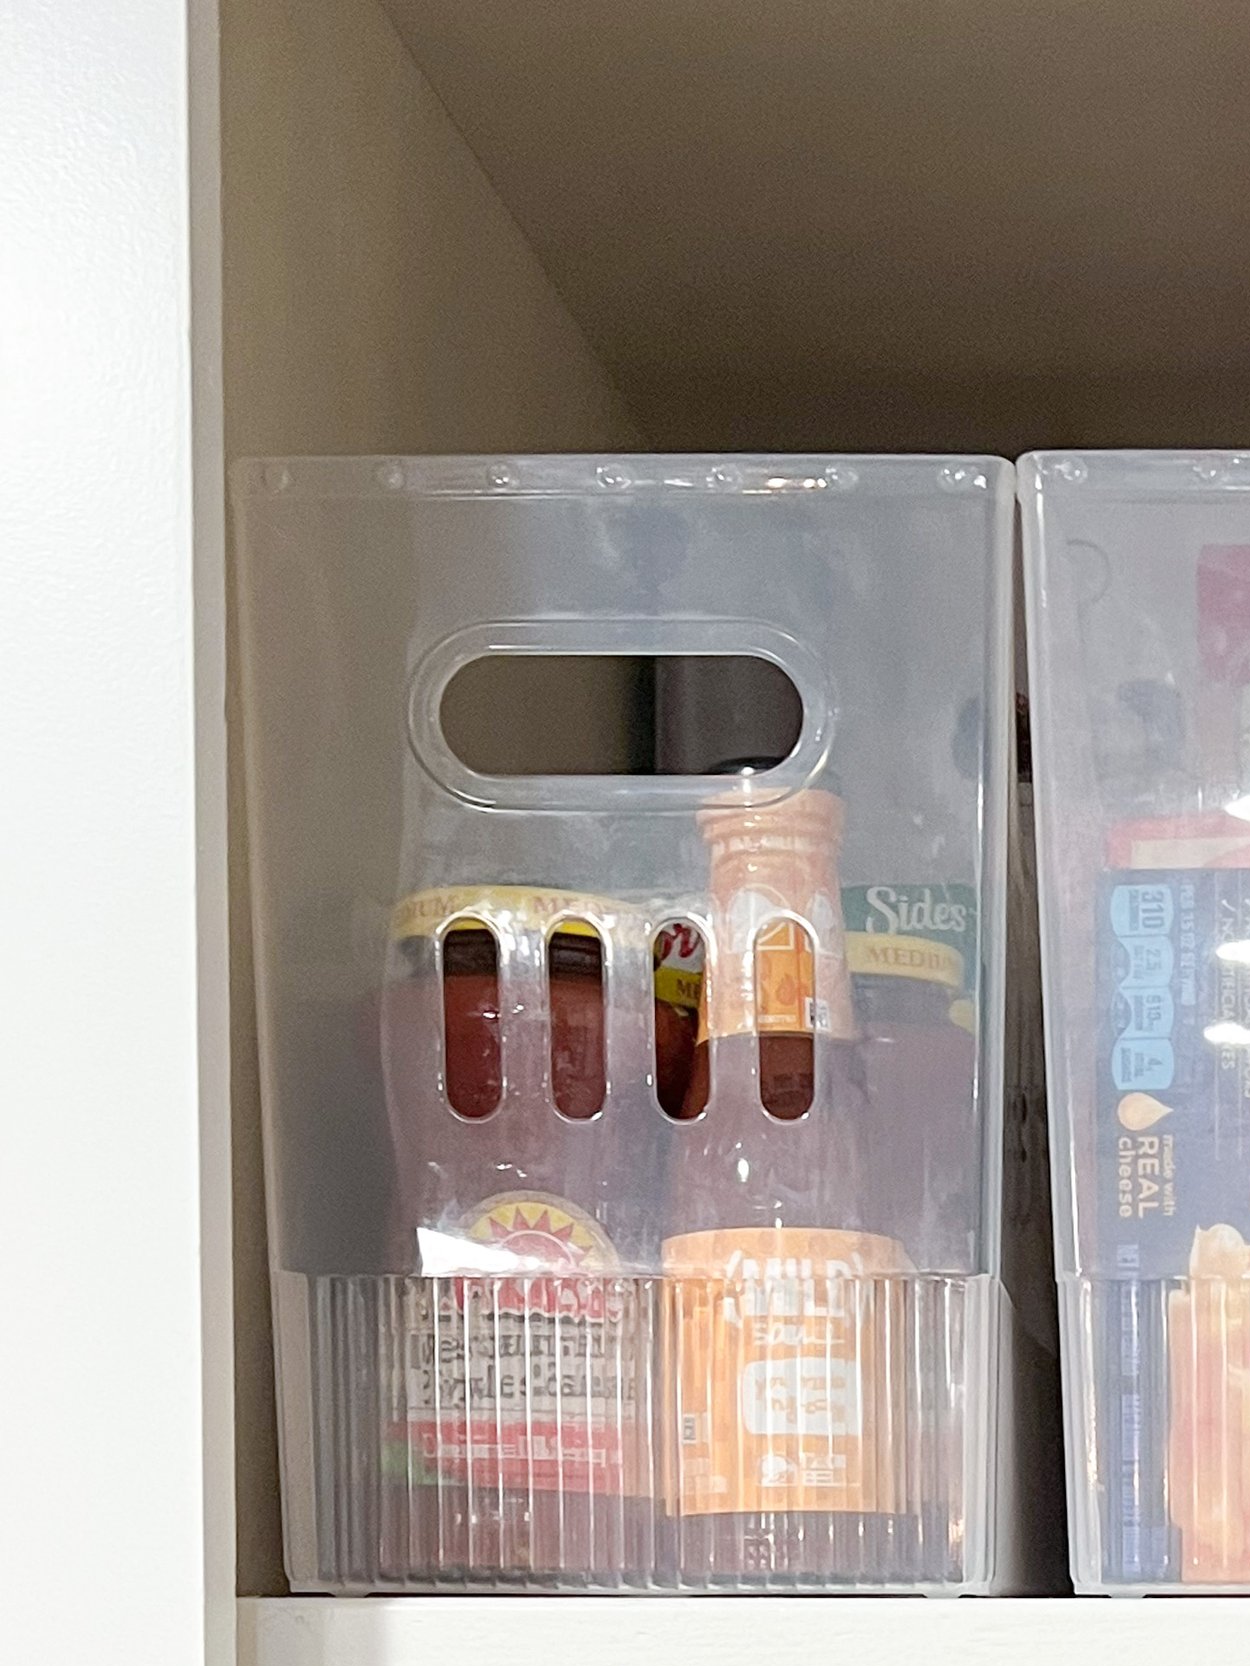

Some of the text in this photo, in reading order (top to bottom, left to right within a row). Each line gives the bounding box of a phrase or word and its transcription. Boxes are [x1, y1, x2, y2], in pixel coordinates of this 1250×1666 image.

[866, 885, 968, 934] Sides
[1141, 890, 1164, 929] 310
[1118, 1137, 1136, 1218] cheese
[1137, 1137, 1159, 1218] REAL
[1162, 1134, 1176, 1216] made with
